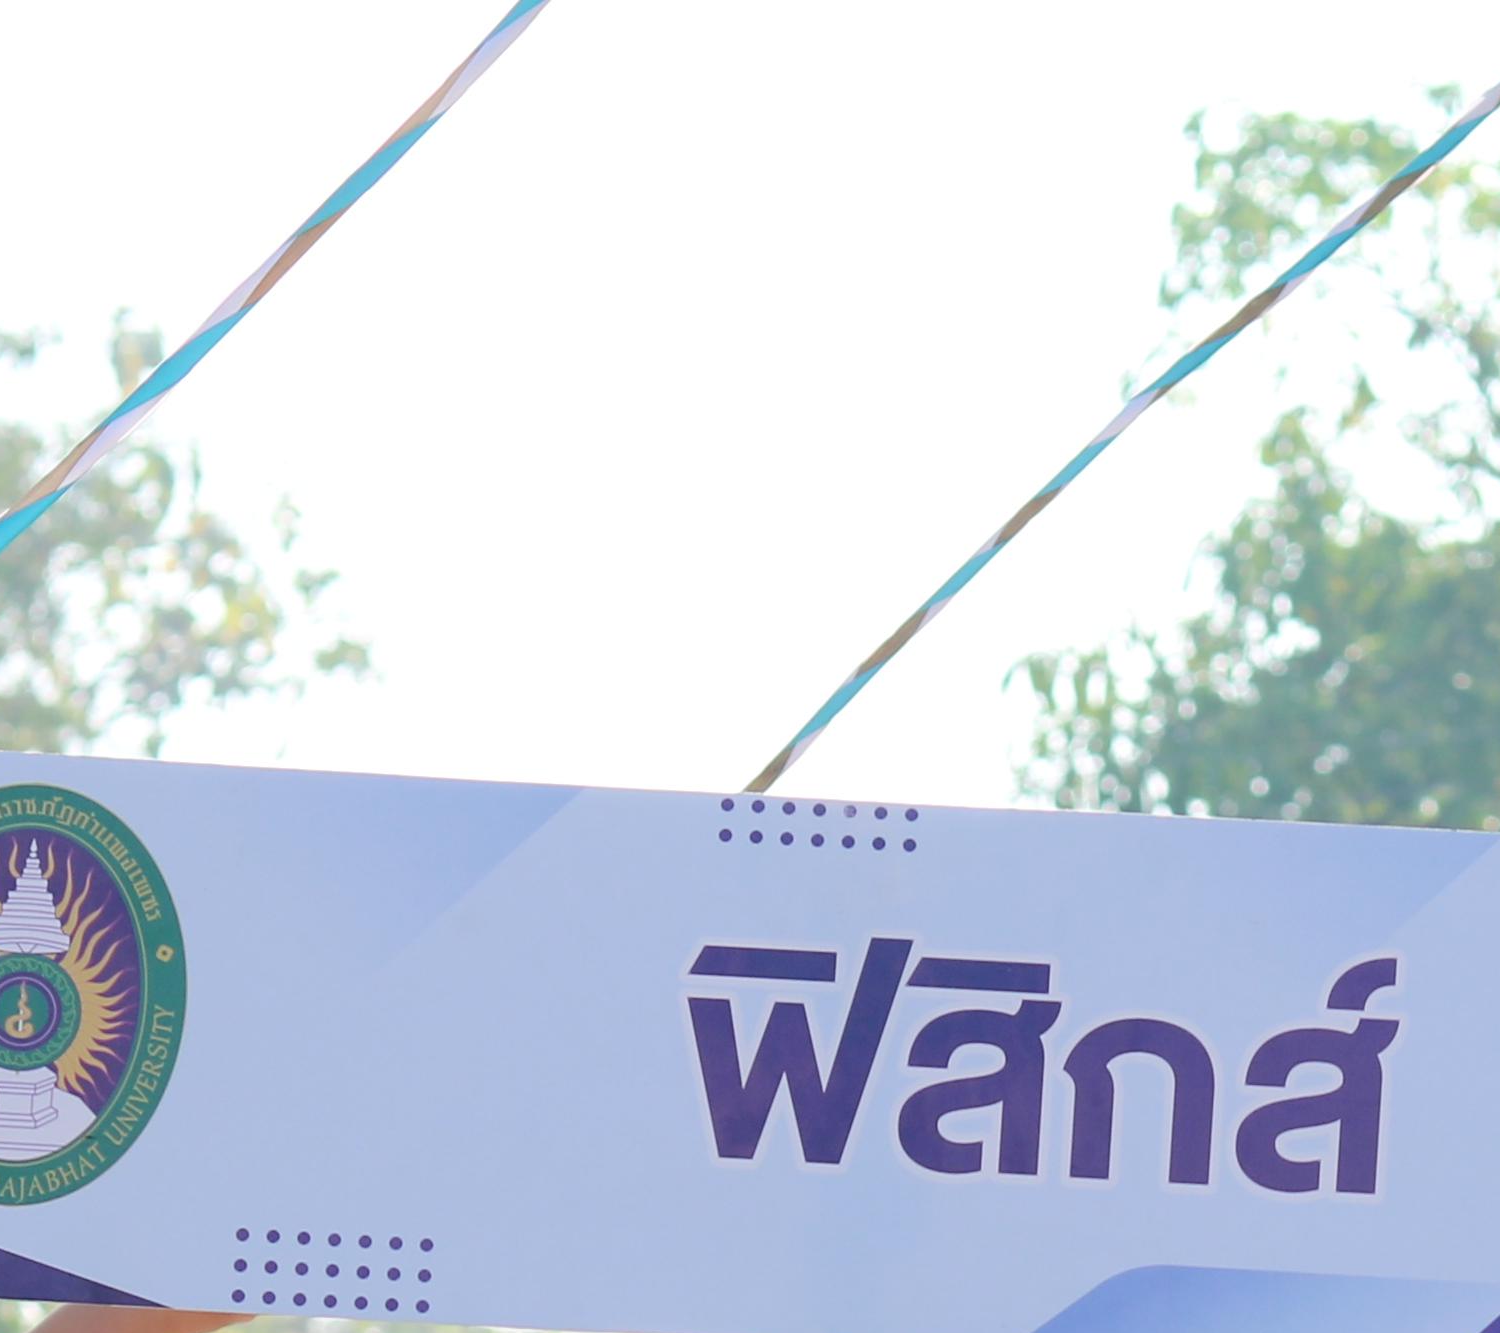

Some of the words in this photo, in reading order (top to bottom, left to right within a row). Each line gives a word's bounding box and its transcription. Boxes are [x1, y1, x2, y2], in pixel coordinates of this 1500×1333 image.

[103, 1004, 176, 1146] UNIVERSITY
[686, 936, 1401, 1195] ฟิสิกส์
